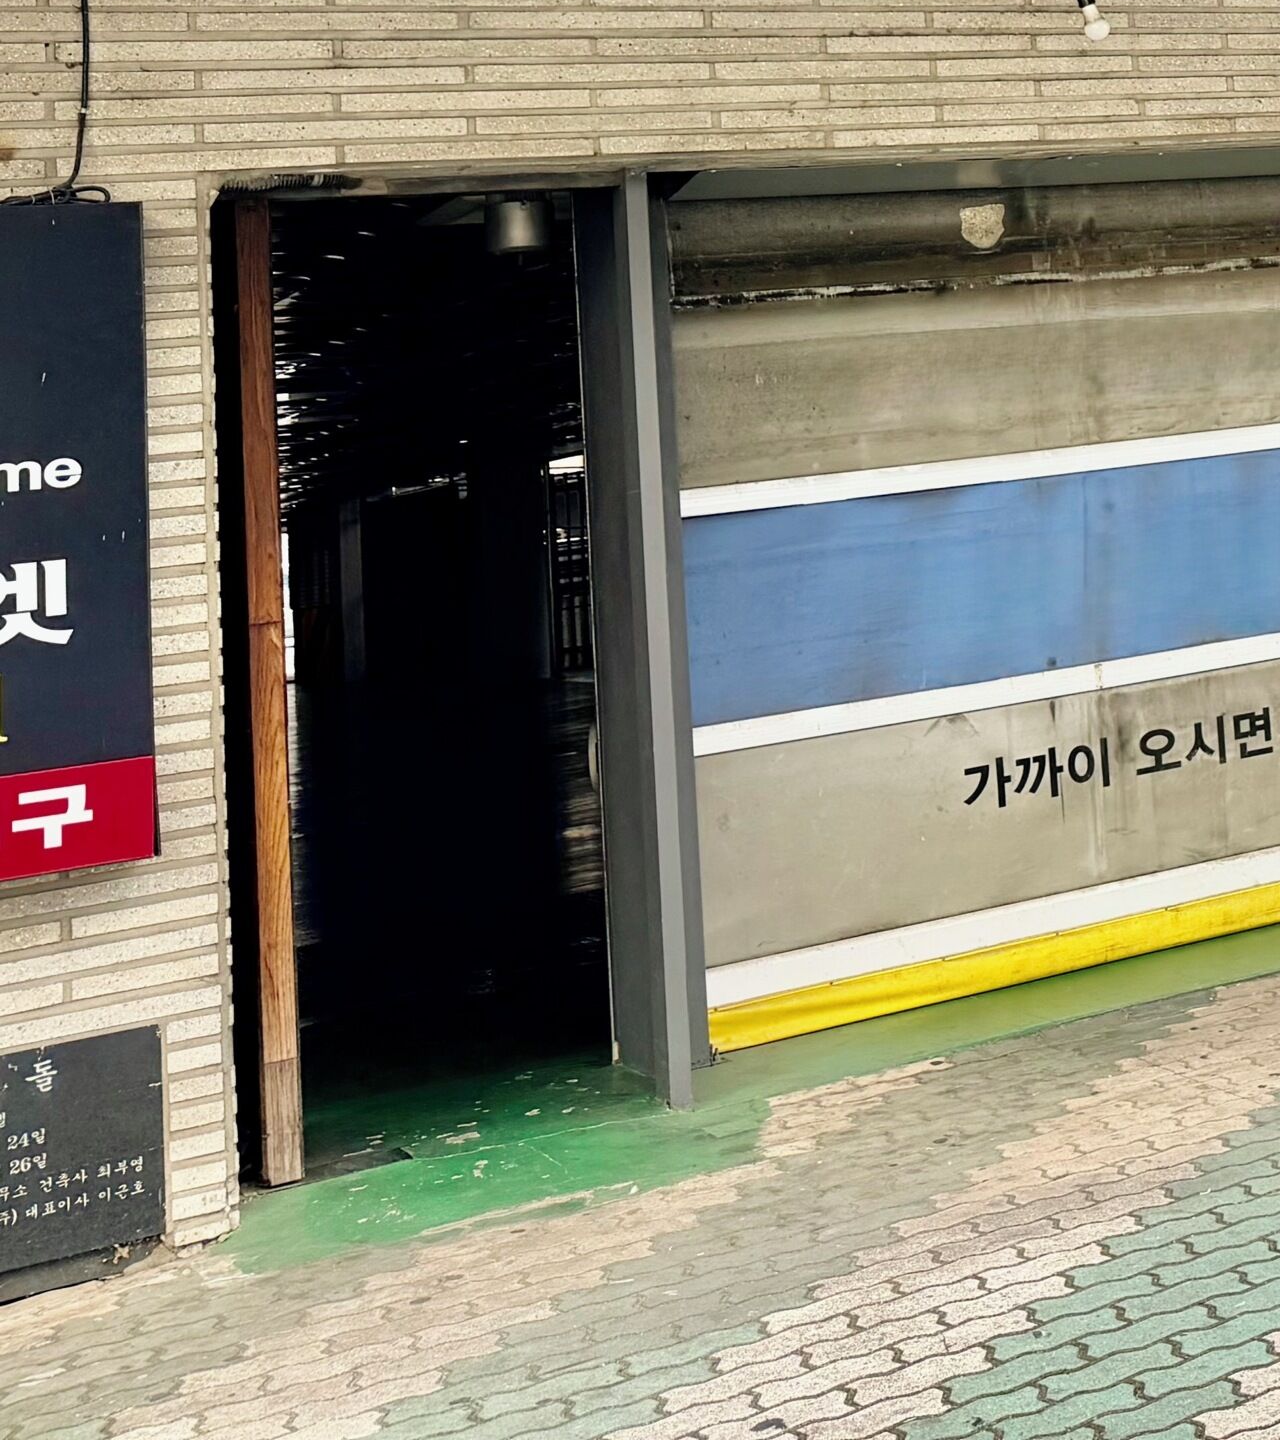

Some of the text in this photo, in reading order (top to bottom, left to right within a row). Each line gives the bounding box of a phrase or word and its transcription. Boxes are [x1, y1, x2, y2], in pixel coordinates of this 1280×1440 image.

[963, 736, 1110, 809] 가까이
[1136, 706, 1274, 777] 오시면
[8, 1128, 46, 1150] 24일
[10, 1153, 47, 1175] 26일
[40, 1169, 88, 1193] 건축사
[26, 1192, 90, 1219] 대표이사
[98, 1180, 145, 1202] 이근호
